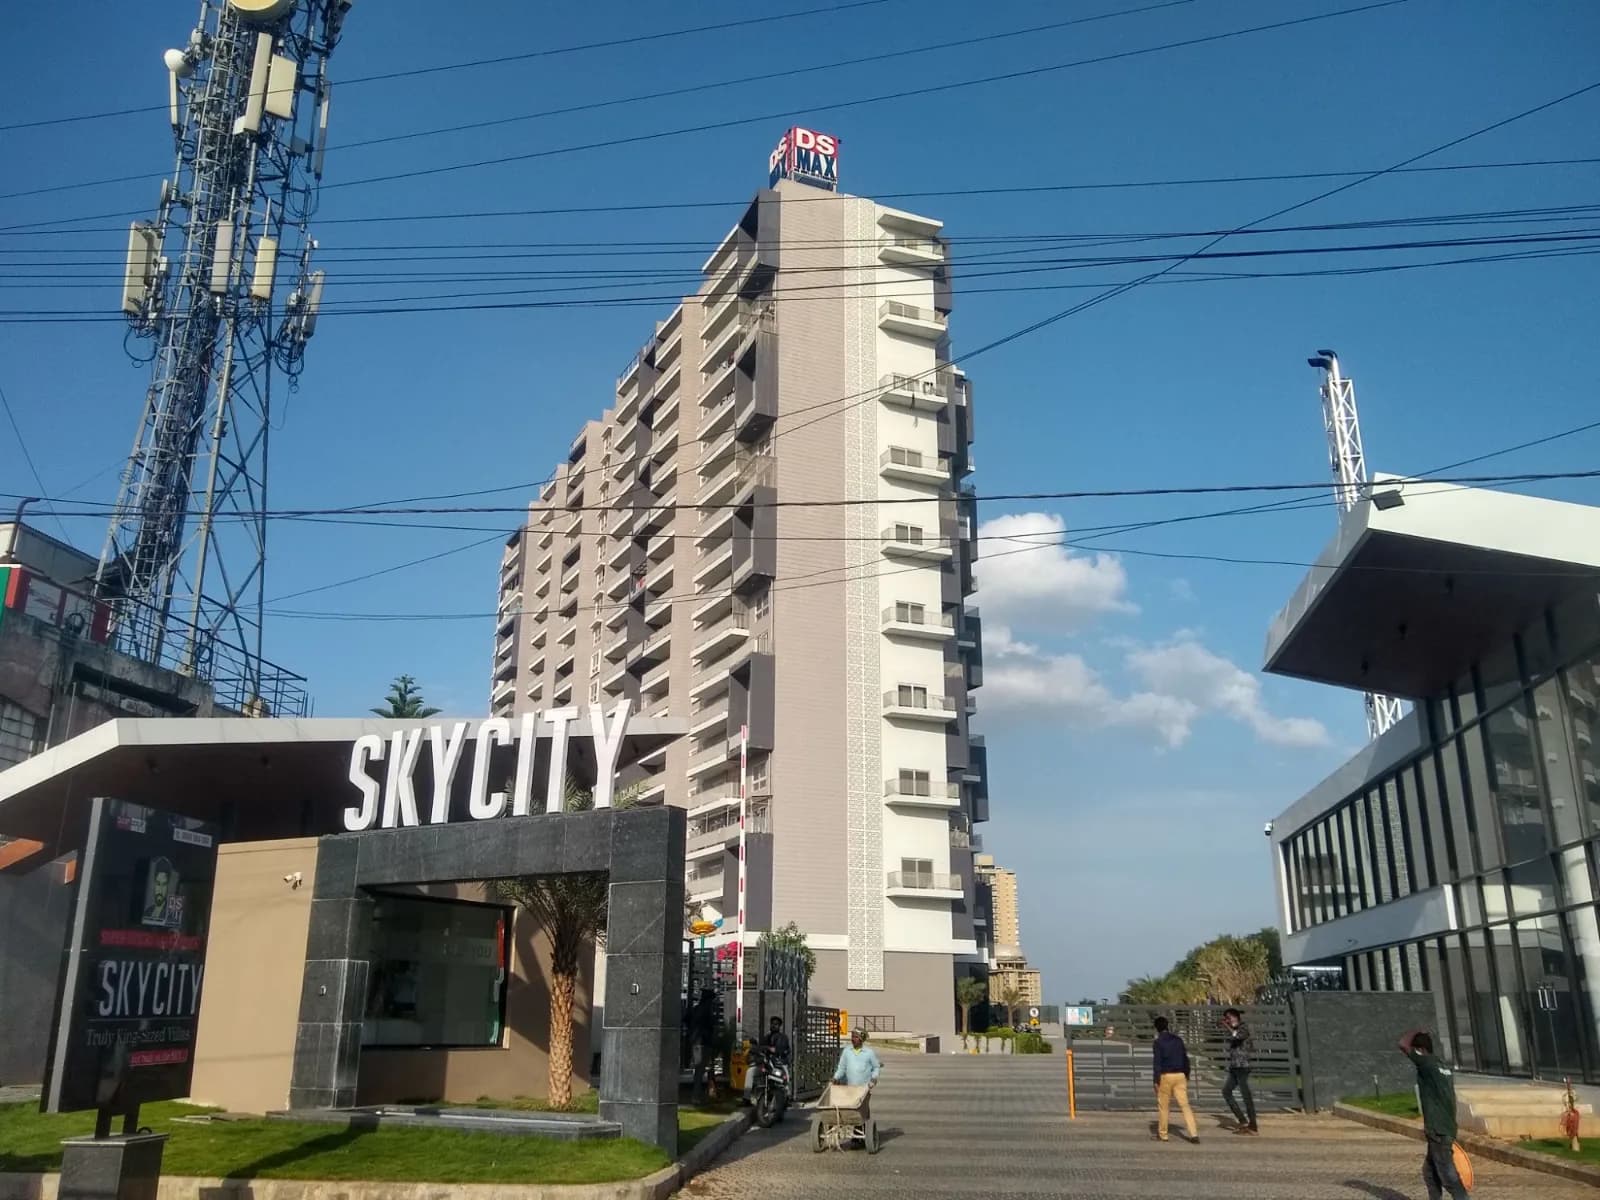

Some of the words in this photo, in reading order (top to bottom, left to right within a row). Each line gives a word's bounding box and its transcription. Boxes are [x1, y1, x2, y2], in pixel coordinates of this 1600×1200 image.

[796, 127, 835, 156] DS
[797, 147, 835, 179] MAX
[343, 698, 633, 832] SKYCITY
[99, 959, 204, 1017] SKYCITY
